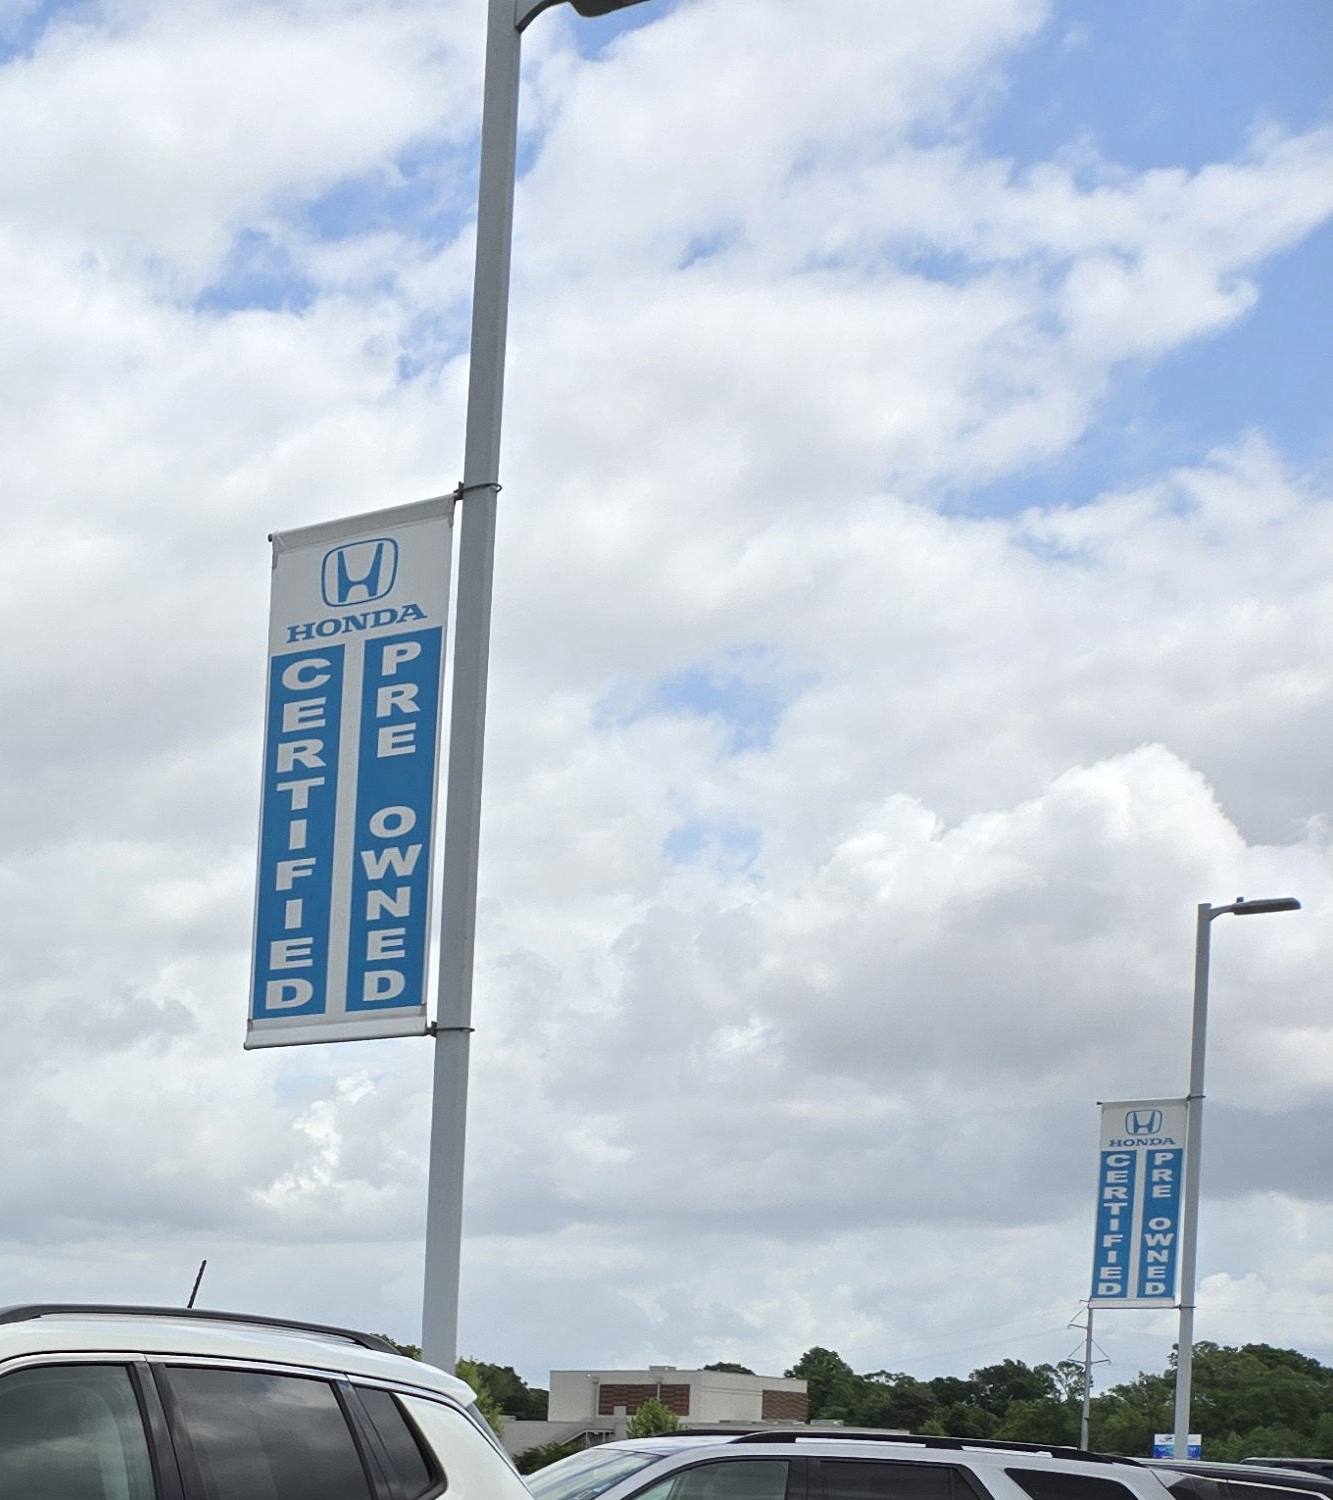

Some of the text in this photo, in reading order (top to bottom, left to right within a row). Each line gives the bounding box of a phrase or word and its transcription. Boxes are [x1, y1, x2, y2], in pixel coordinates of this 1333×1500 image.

[286, 603, 428, 643] HONDA
[264, 658, 332, 1010] CERTIFIED
[361, 641, 423, 1002] PRE OWNED
[1108, 1137, 1176, 1148] HONDA
[1097, 1154, 1131, 1296] CERTIFIED
[1144, 1152, 1174, 1296] PRE OWNED
